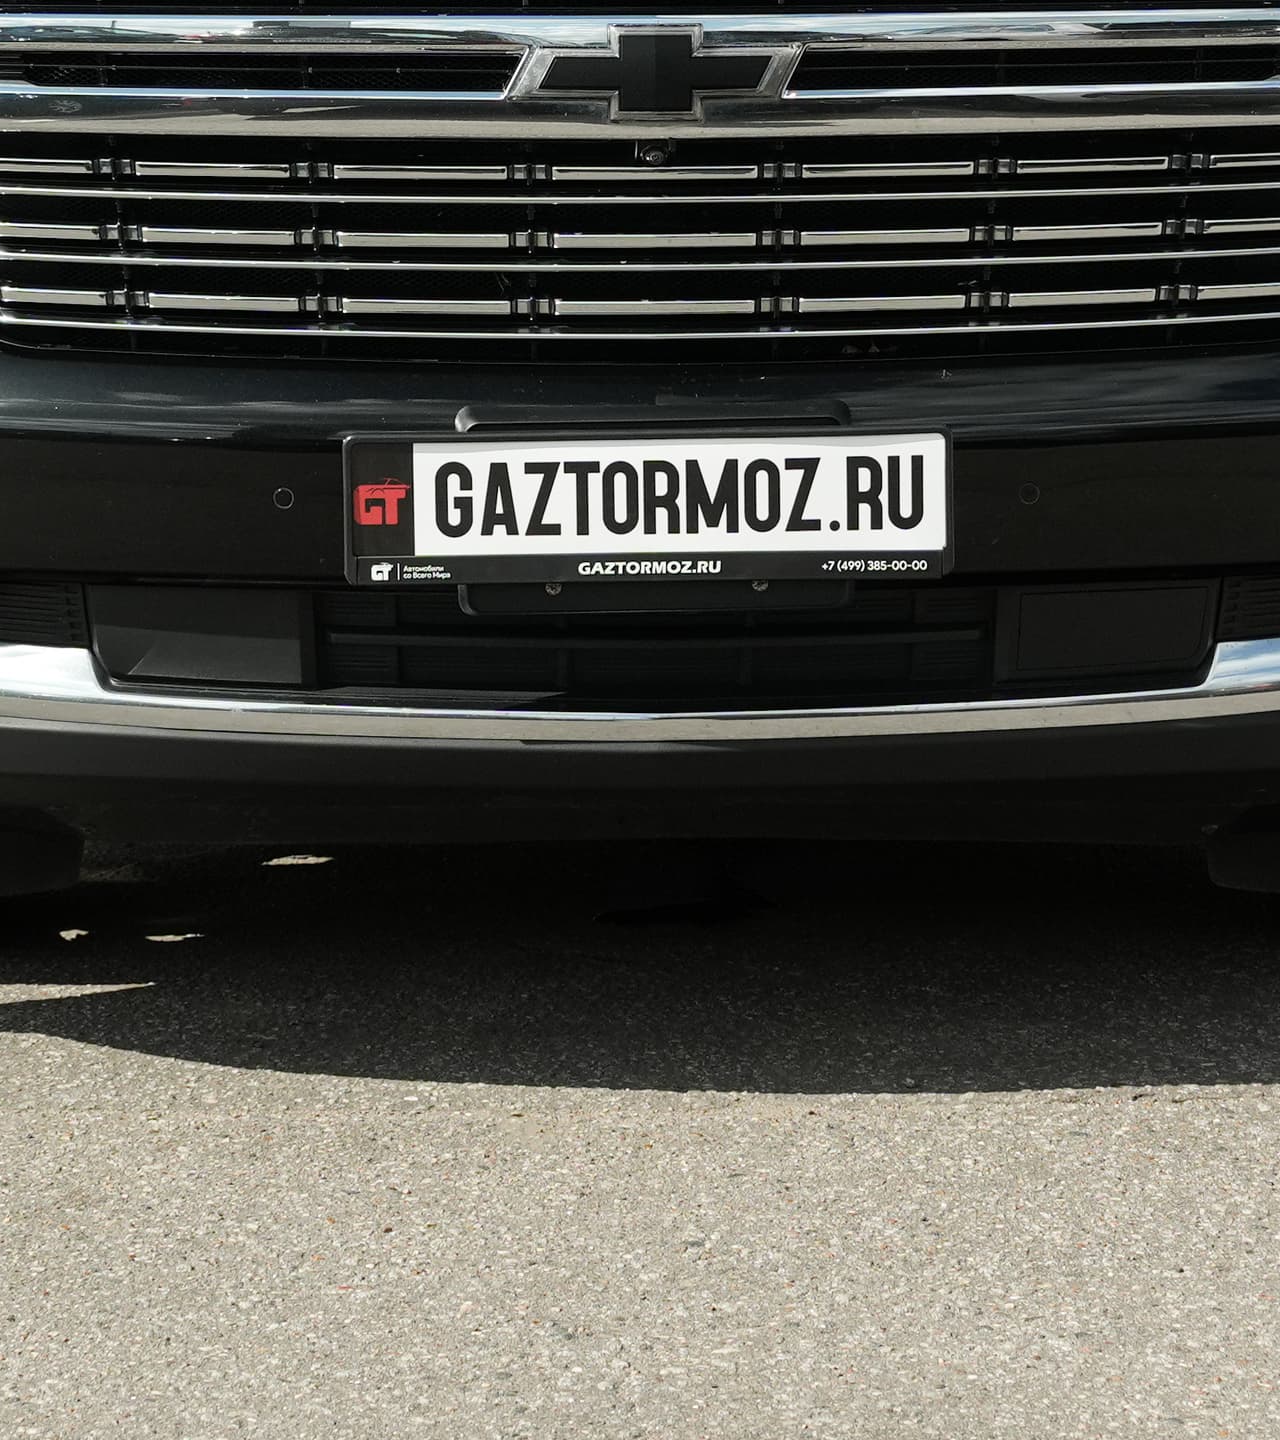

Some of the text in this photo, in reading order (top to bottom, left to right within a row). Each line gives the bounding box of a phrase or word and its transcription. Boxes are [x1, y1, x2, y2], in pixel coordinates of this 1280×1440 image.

[433, 455, 925, 538] GAZTORMOZ.RU
[577, 560, 722, 576] GAZTORMOZ.RU
[821, 559, 927, 572] +7 (499) 385-00-00
